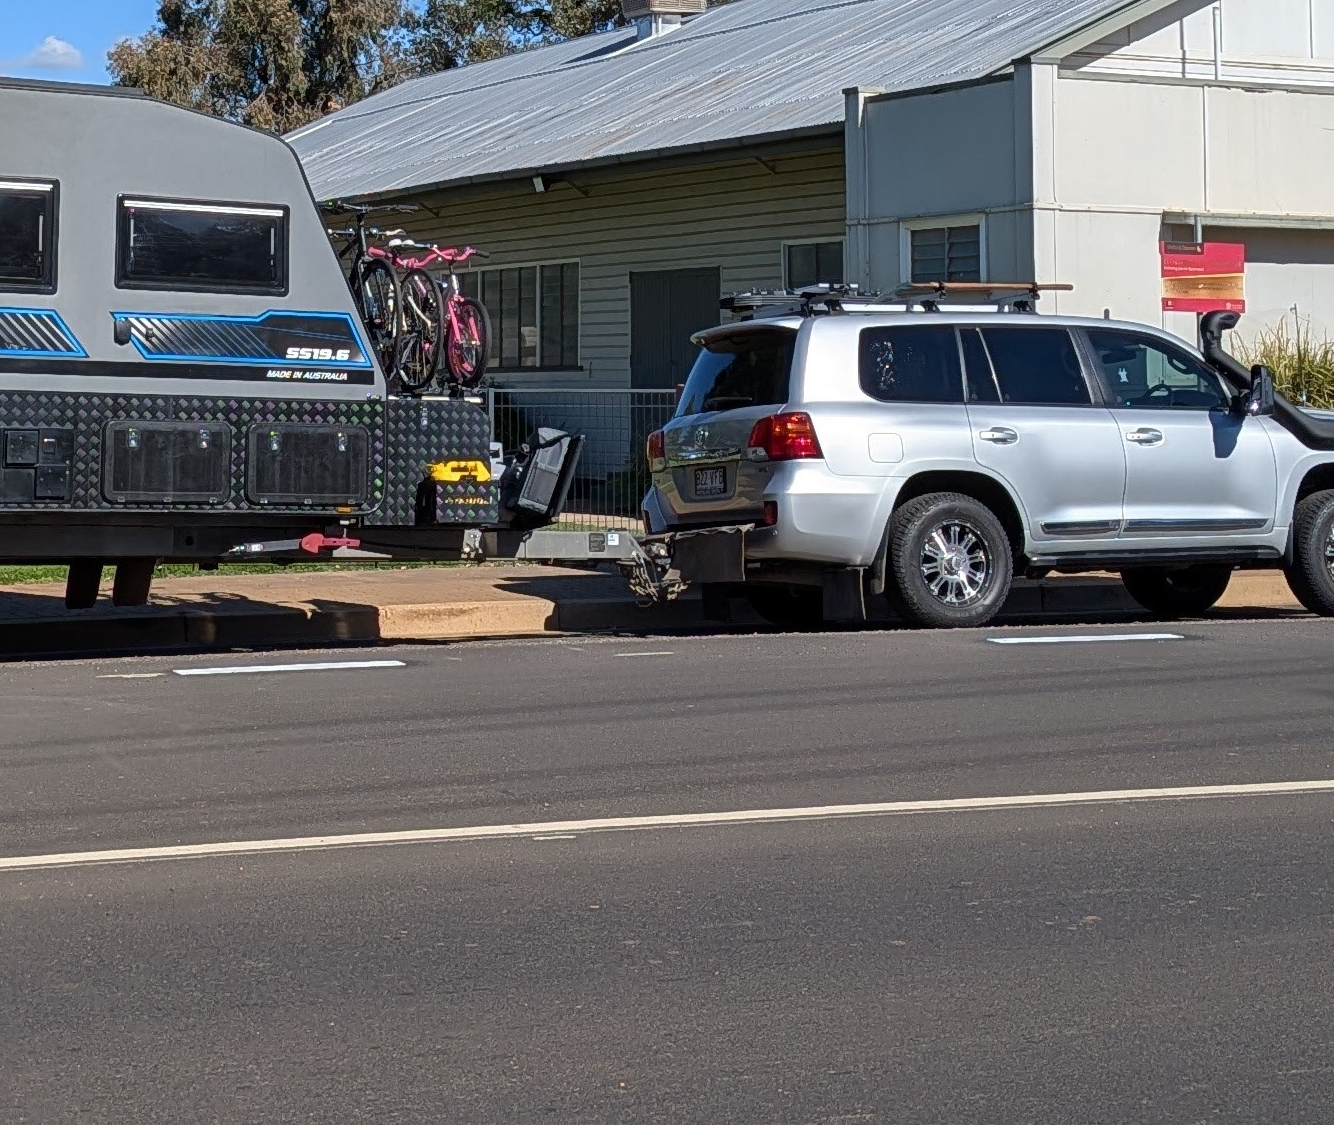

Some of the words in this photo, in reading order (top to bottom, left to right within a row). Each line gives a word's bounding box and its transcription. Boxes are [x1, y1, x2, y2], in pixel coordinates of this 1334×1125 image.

[285, 347, 351, 361] SS19.6
[266, 369, 292, 379] MADE
[292, 370, 303, 379] IN
[303, 371, 348, 381] AUSTRALIA
